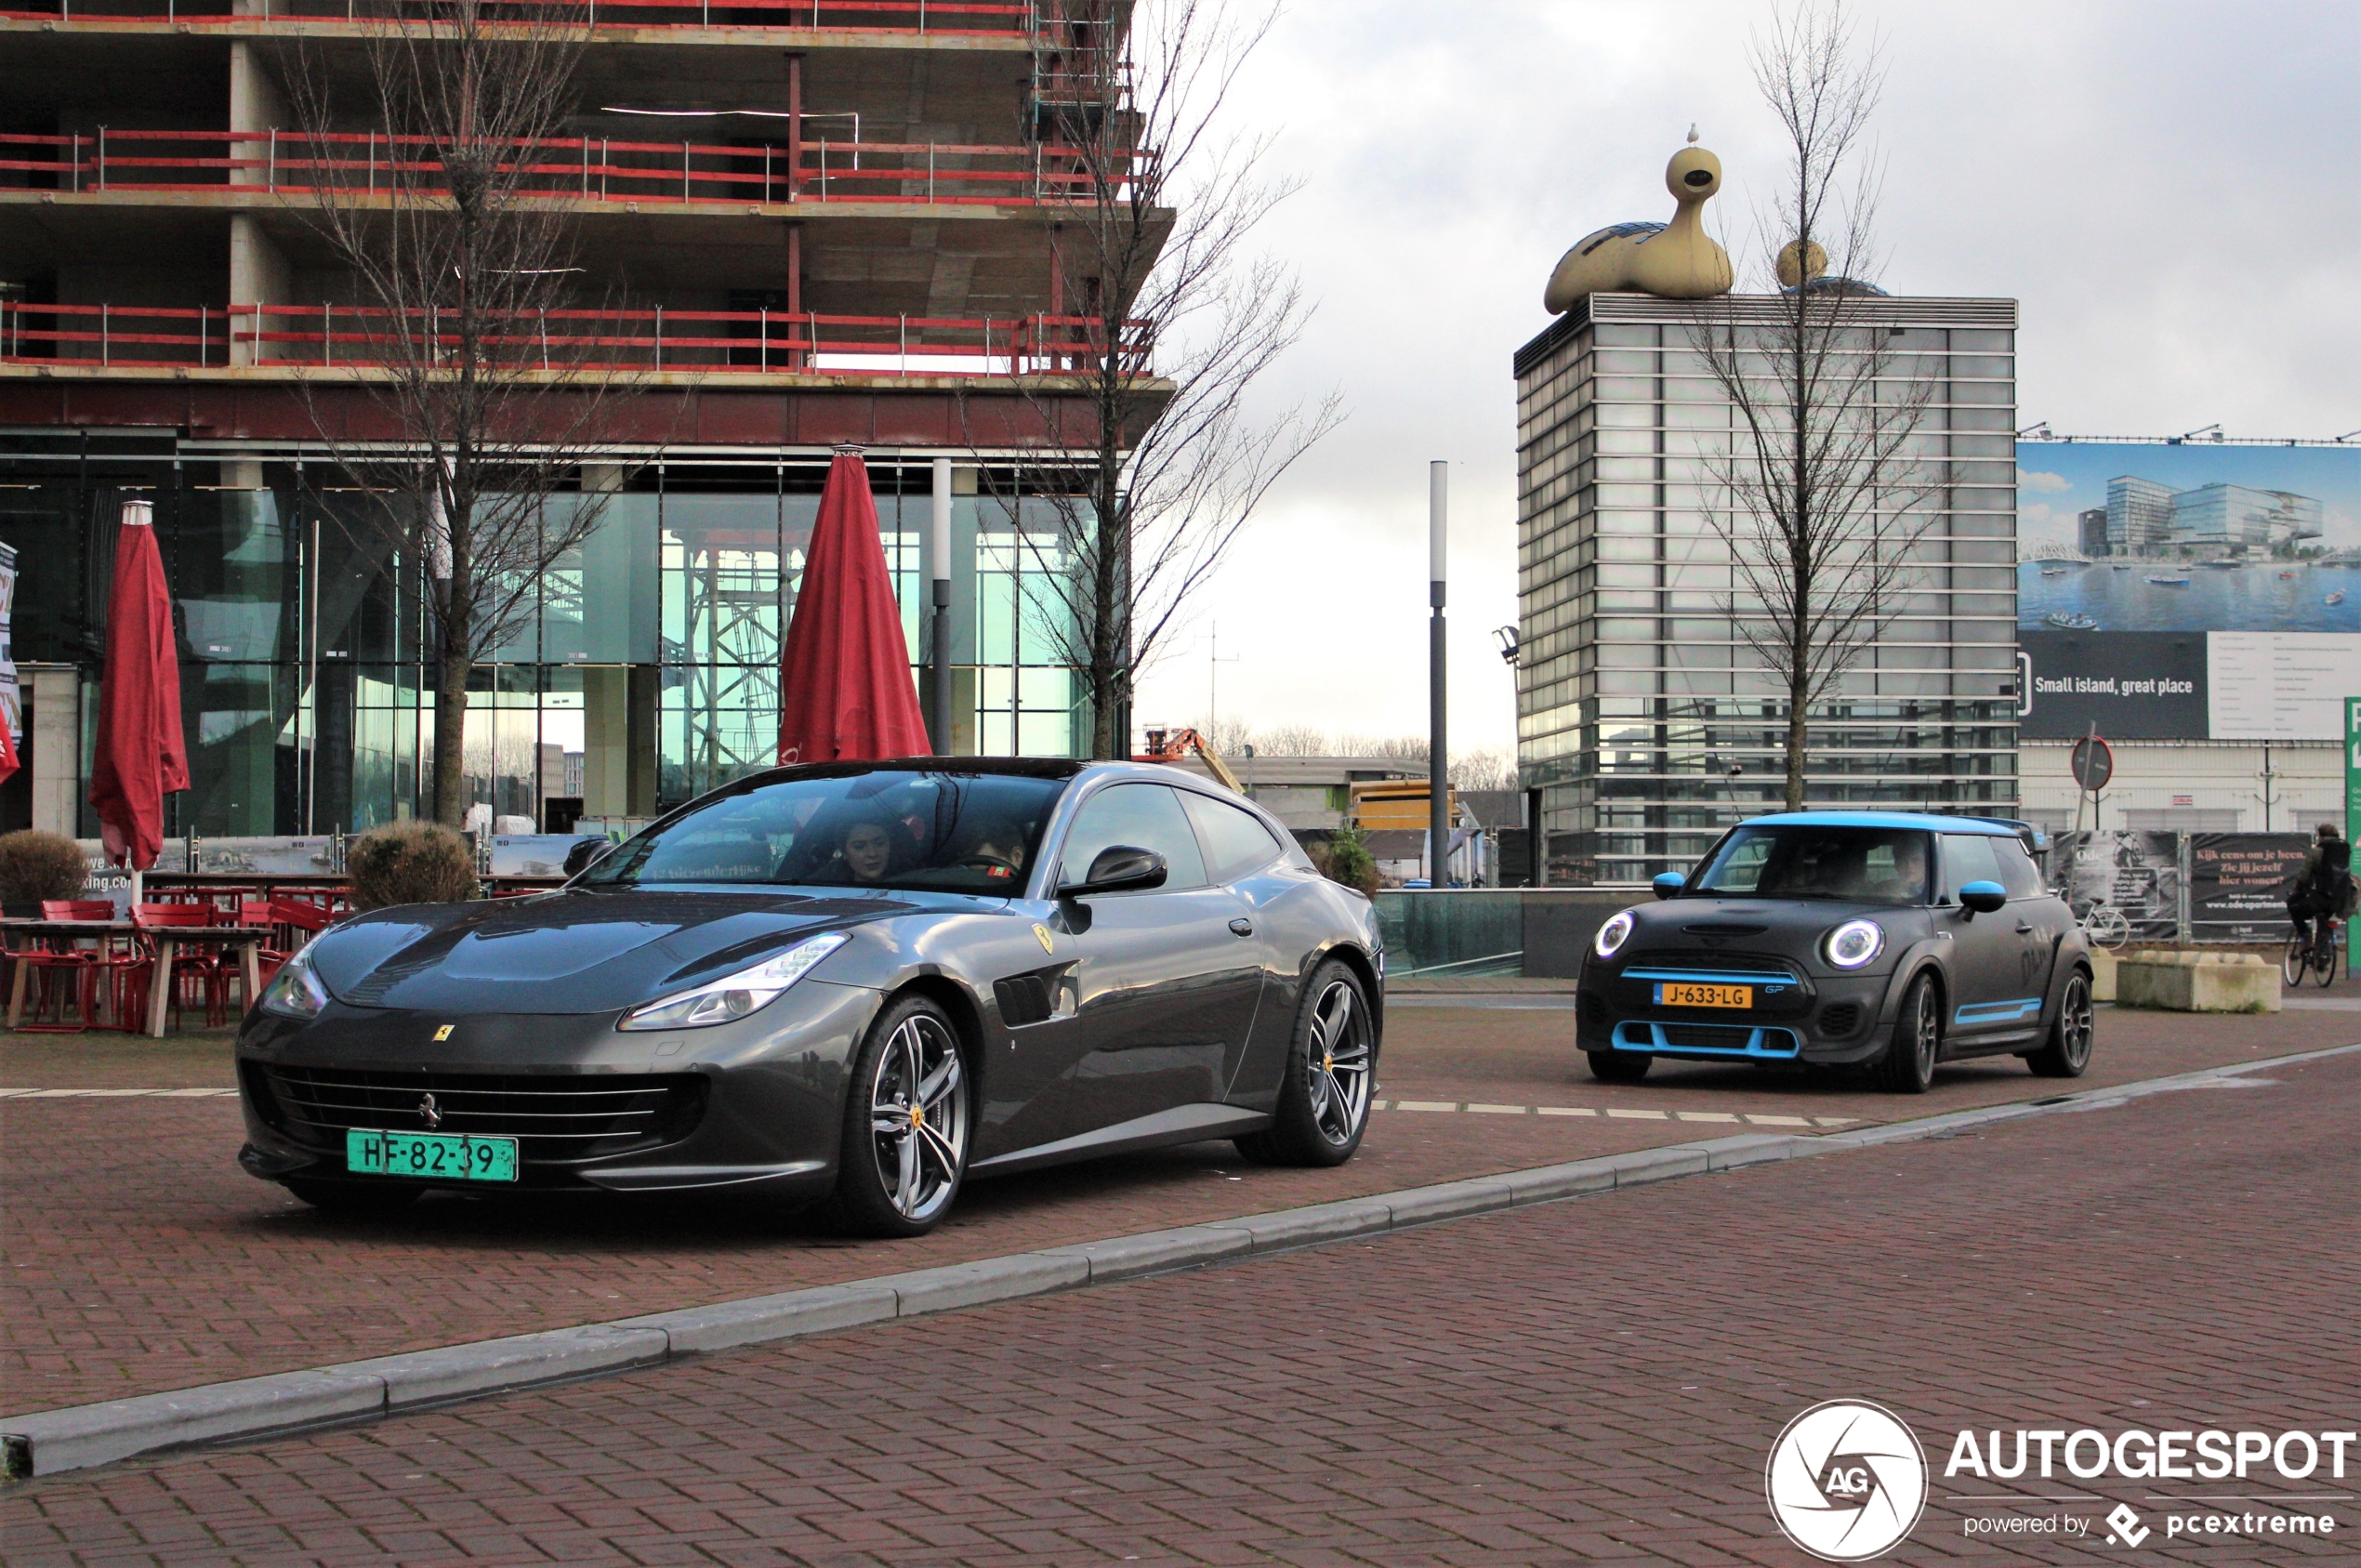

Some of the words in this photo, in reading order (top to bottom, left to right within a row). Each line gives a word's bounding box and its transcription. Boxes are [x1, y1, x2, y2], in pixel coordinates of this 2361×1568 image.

[2036, 677, 2073, 692] Small
[2076, 677, 2118, 695] island,
[2121, 679, 2156, 697] great
[2158, 678, 2193, 696] place
[2196, 850, 2219, 861] Kijk
[2221, 851, 2245, 860] eens
[2248, 851, 2263, 860] om
[2264, 850, 2275, 861] je
[2221, 863, 2237, 872] Zie
[2249, 863, 2283, 874] jezelf
[2219, 876, 2241, 885] hier
[1765, 985, 1785, 994] GP
[1670, 986, 1744, 1005] J-633-LG
[364, 1139, 494, 1173] HF-82-39
